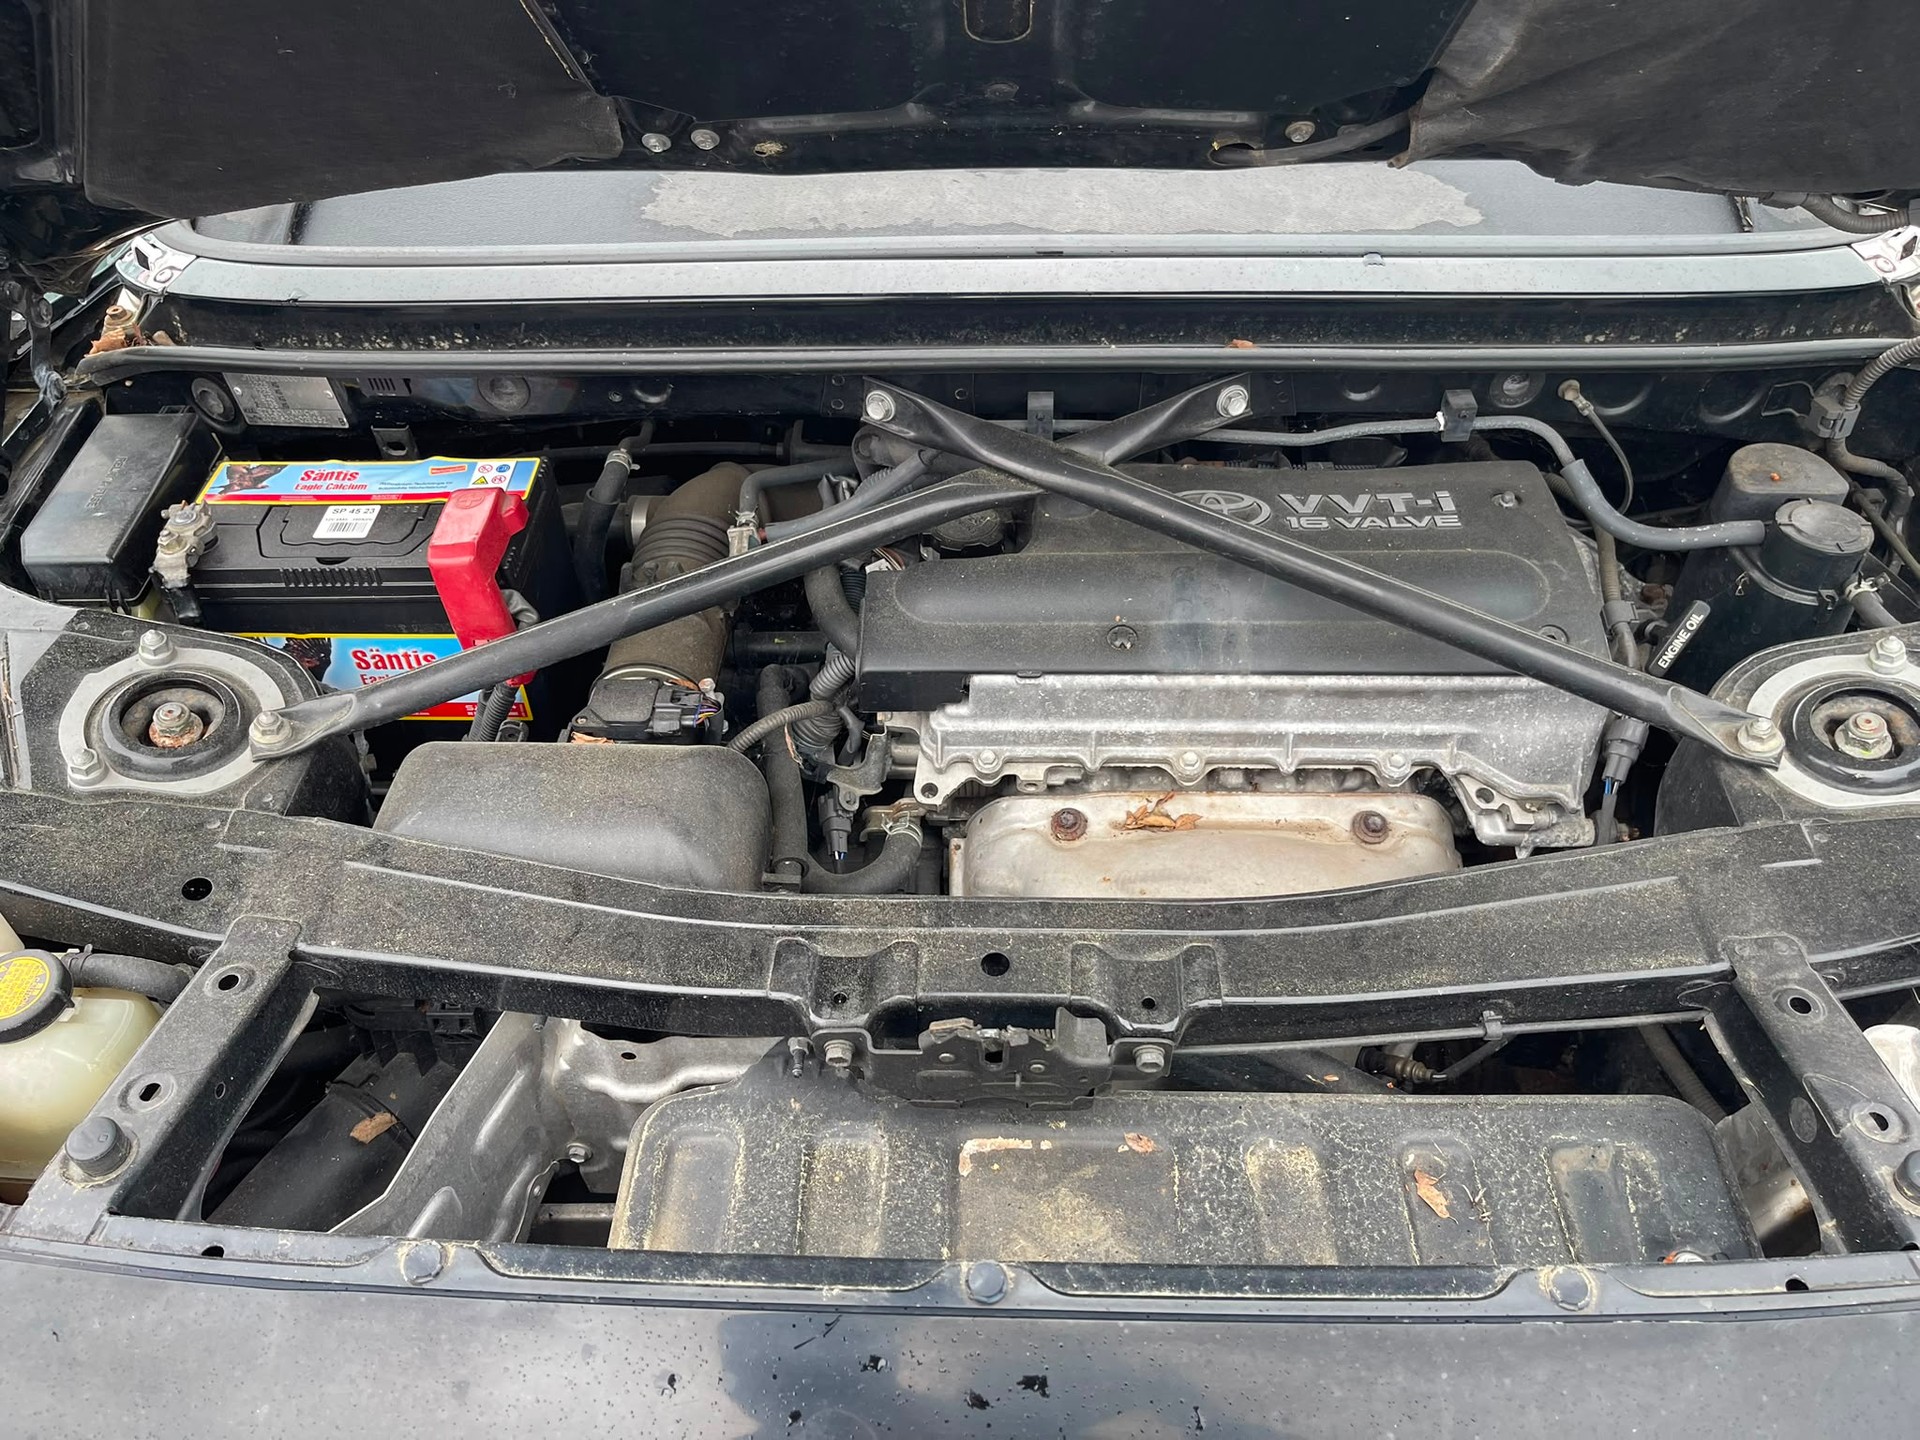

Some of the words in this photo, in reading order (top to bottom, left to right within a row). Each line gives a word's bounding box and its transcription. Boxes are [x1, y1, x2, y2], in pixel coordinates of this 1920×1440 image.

[300, 469, 360, 482] Säntis
[294, 483, 323, 492] Eagle
[325, 483, 368, 491] Calcium
[1277, 490, 1457, 514] VVT-i
[1285, 515, 1331, 530] 16
[1333, 514, 1462, 530] VALVE
[1657, 629, 1691, 669] ENGINE
[1685, 613, 1704, 631] OIL
